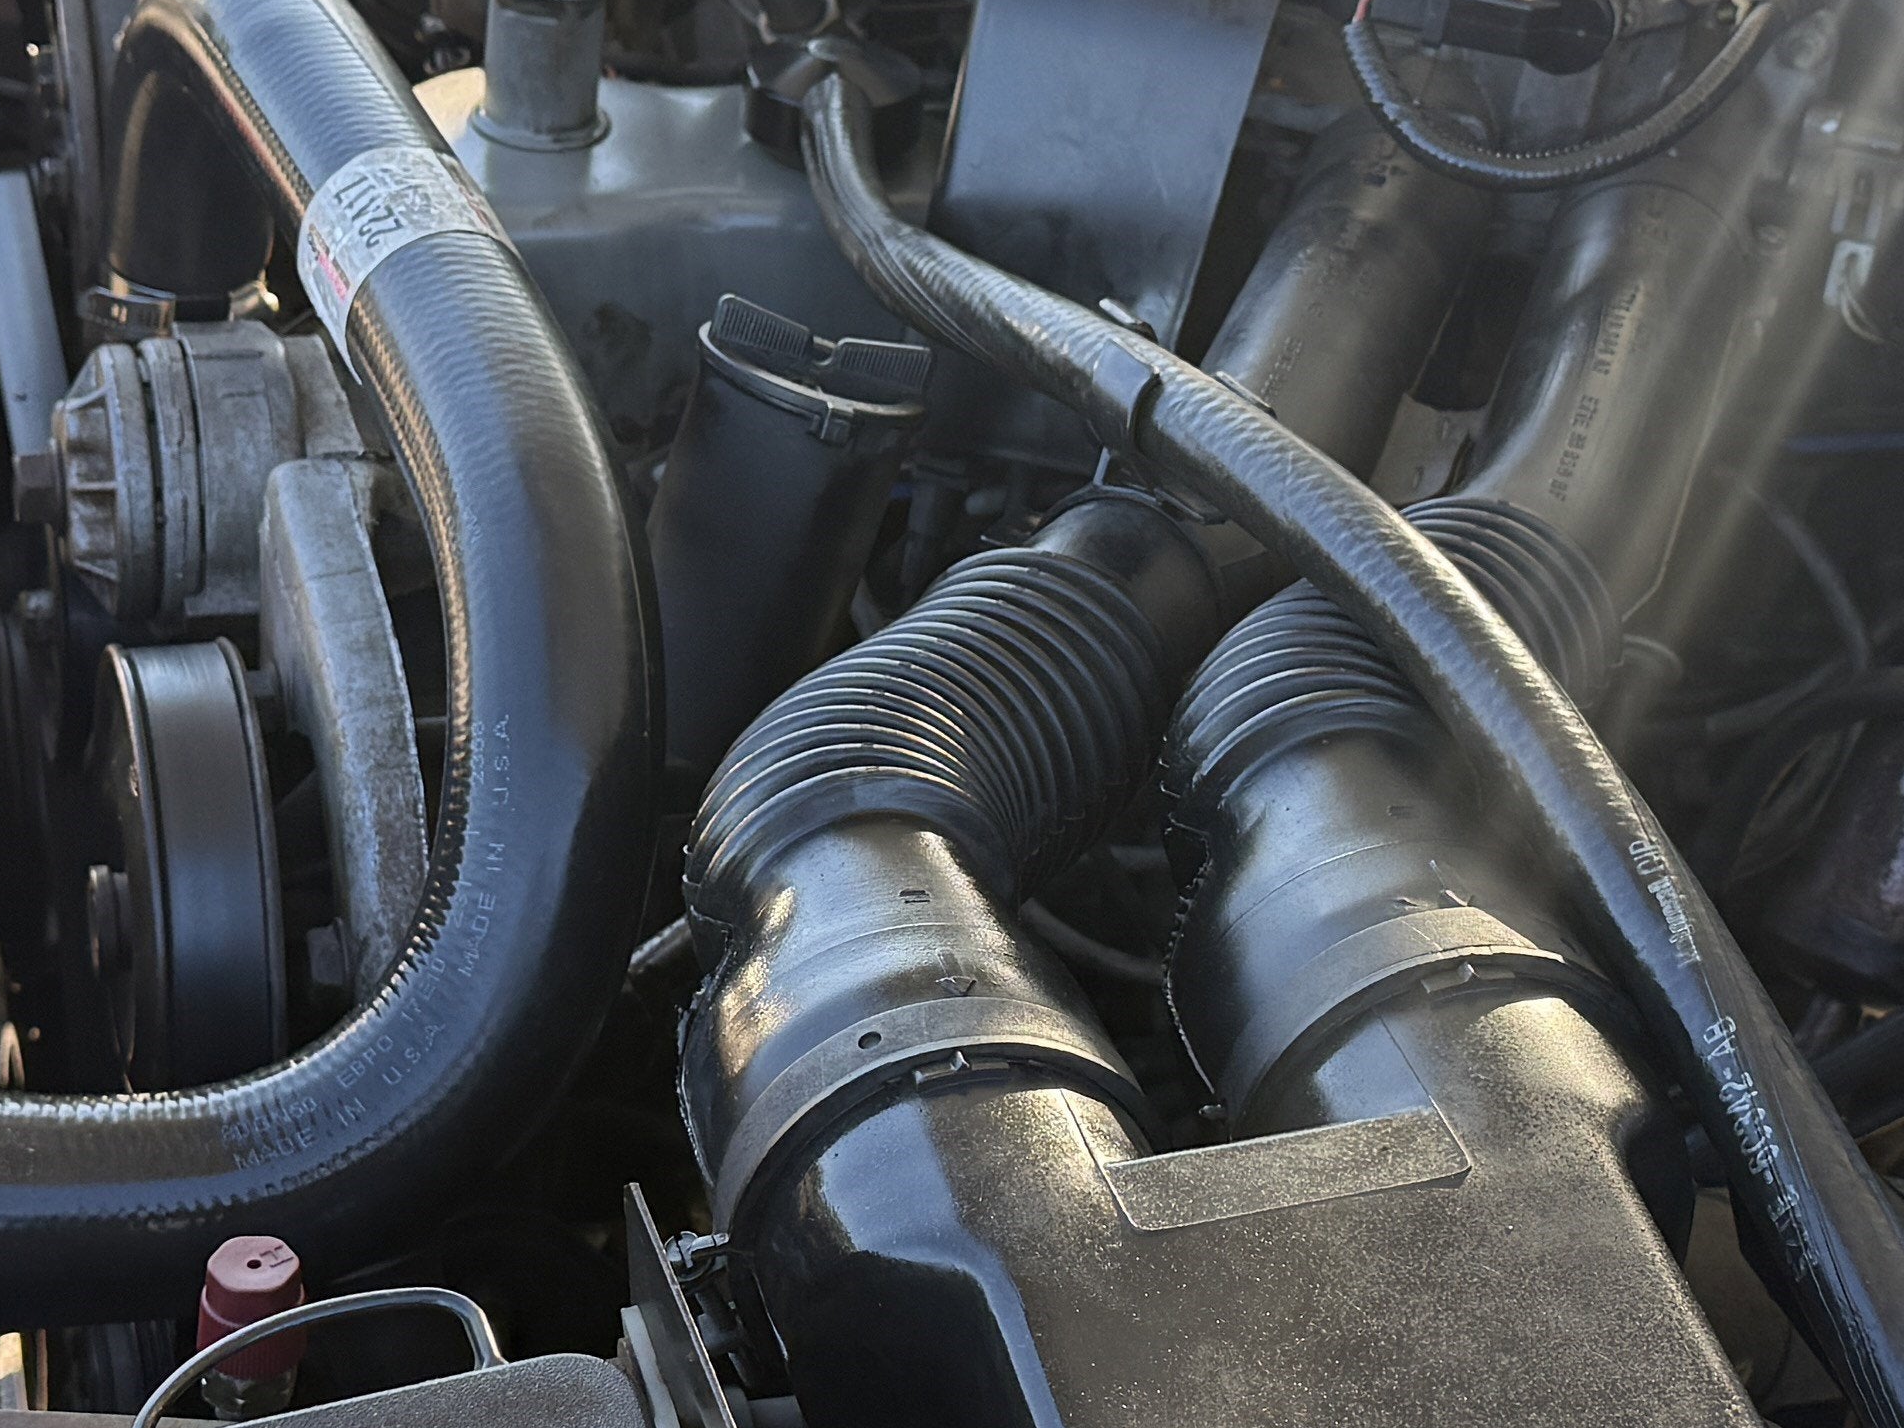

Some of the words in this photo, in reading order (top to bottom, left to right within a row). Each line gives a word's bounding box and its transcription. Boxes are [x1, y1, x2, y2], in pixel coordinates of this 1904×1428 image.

[232, 1125, 316, 1174] MADE
[333, 1095, 369, 1132] IN
[457, 889, 499, 980] MADE
[484, 840, 506, 874] IN
